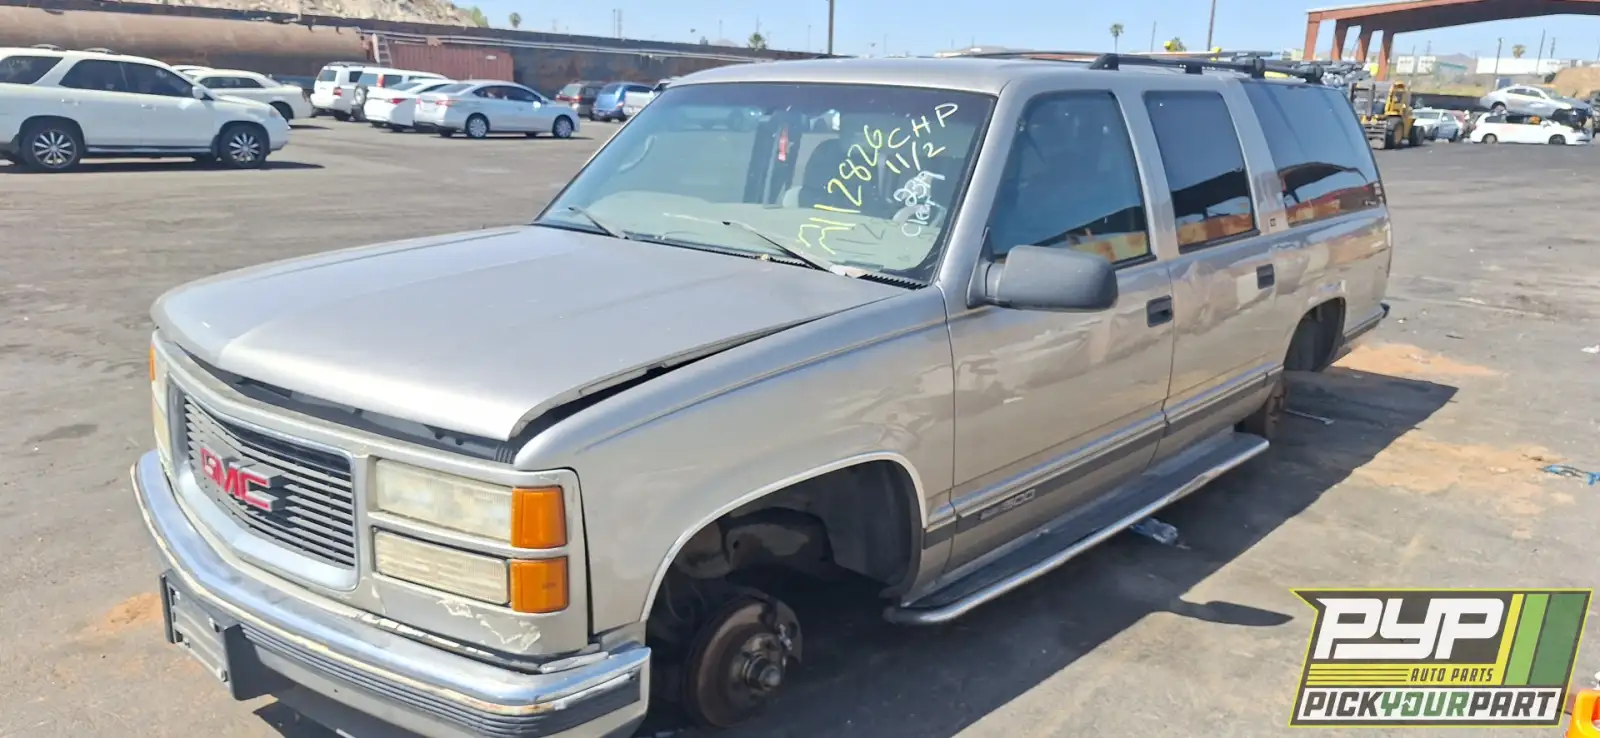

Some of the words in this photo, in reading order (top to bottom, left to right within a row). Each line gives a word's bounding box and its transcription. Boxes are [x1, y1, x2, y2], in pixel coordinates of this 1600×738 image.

[888, 102, 958, 149] CHP
[886, 141, 946, 174] 11/2
[200, 446, 276, 513] GMC
